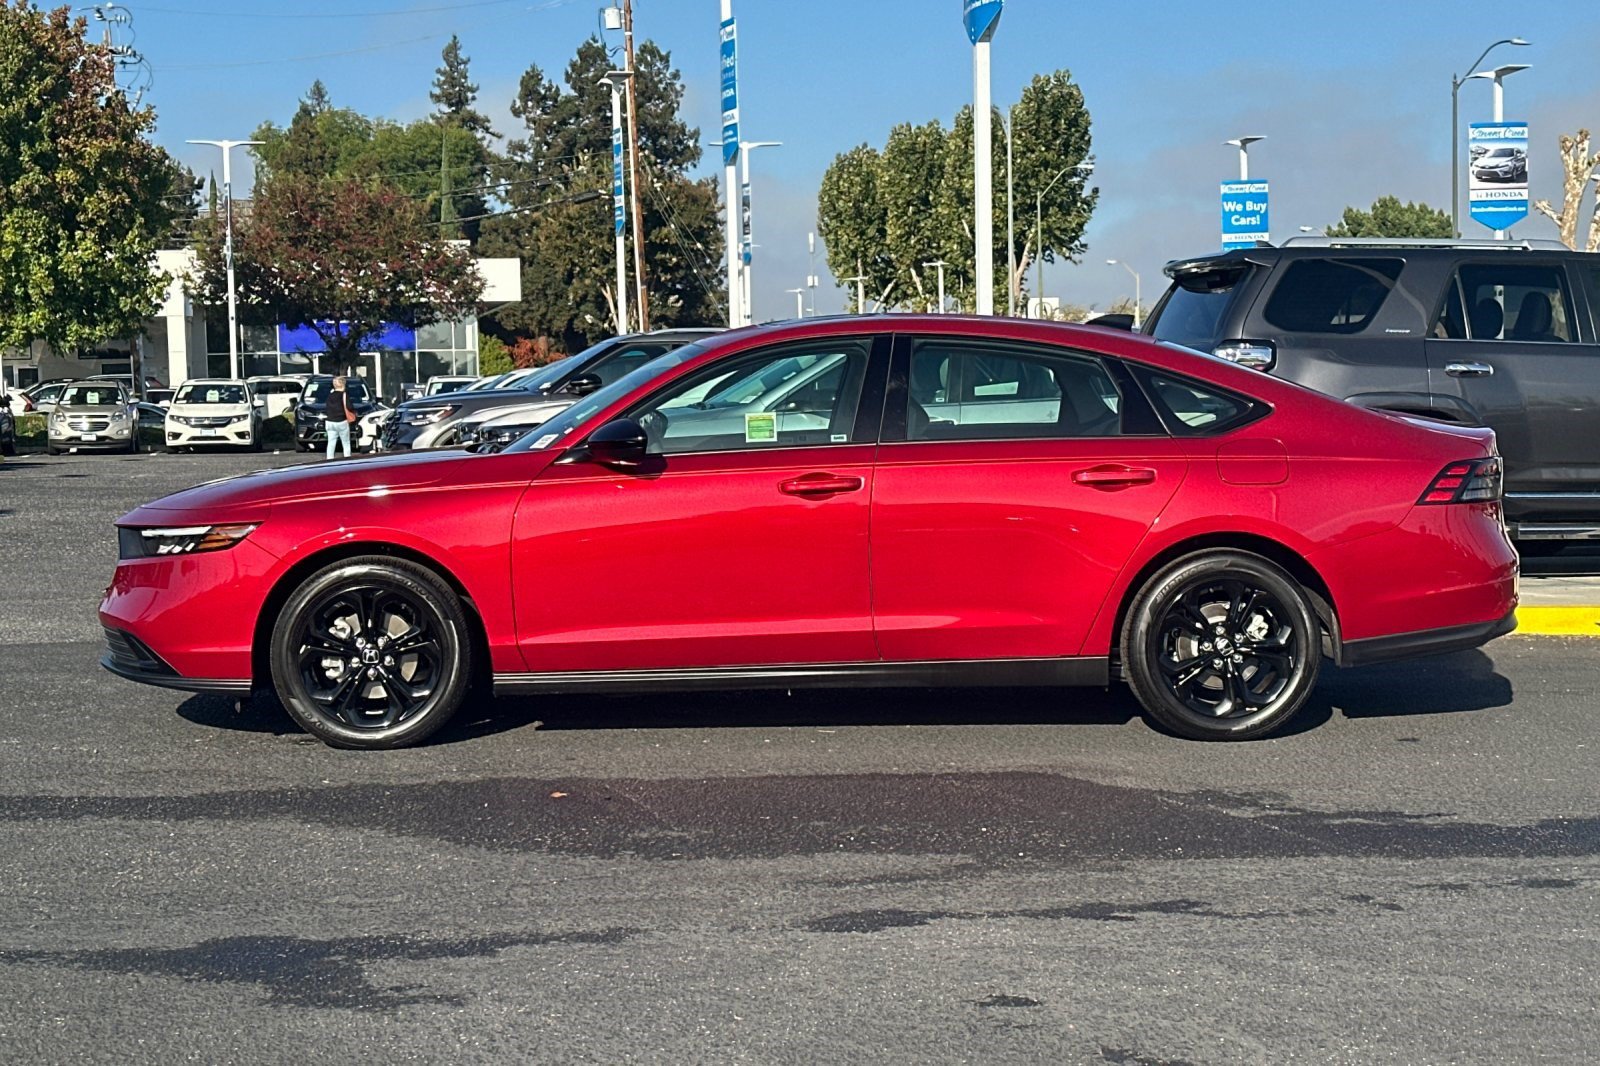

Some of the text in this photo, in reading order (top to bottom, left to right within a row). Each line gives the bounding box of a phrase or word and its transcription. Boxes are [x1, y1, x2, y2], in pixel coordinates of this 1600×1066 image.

[1485, 191, 1524, 199] HONDA
[1222, 200, 1267, 214] We Buy
[1230, 214, 1261, 226] Cars!
